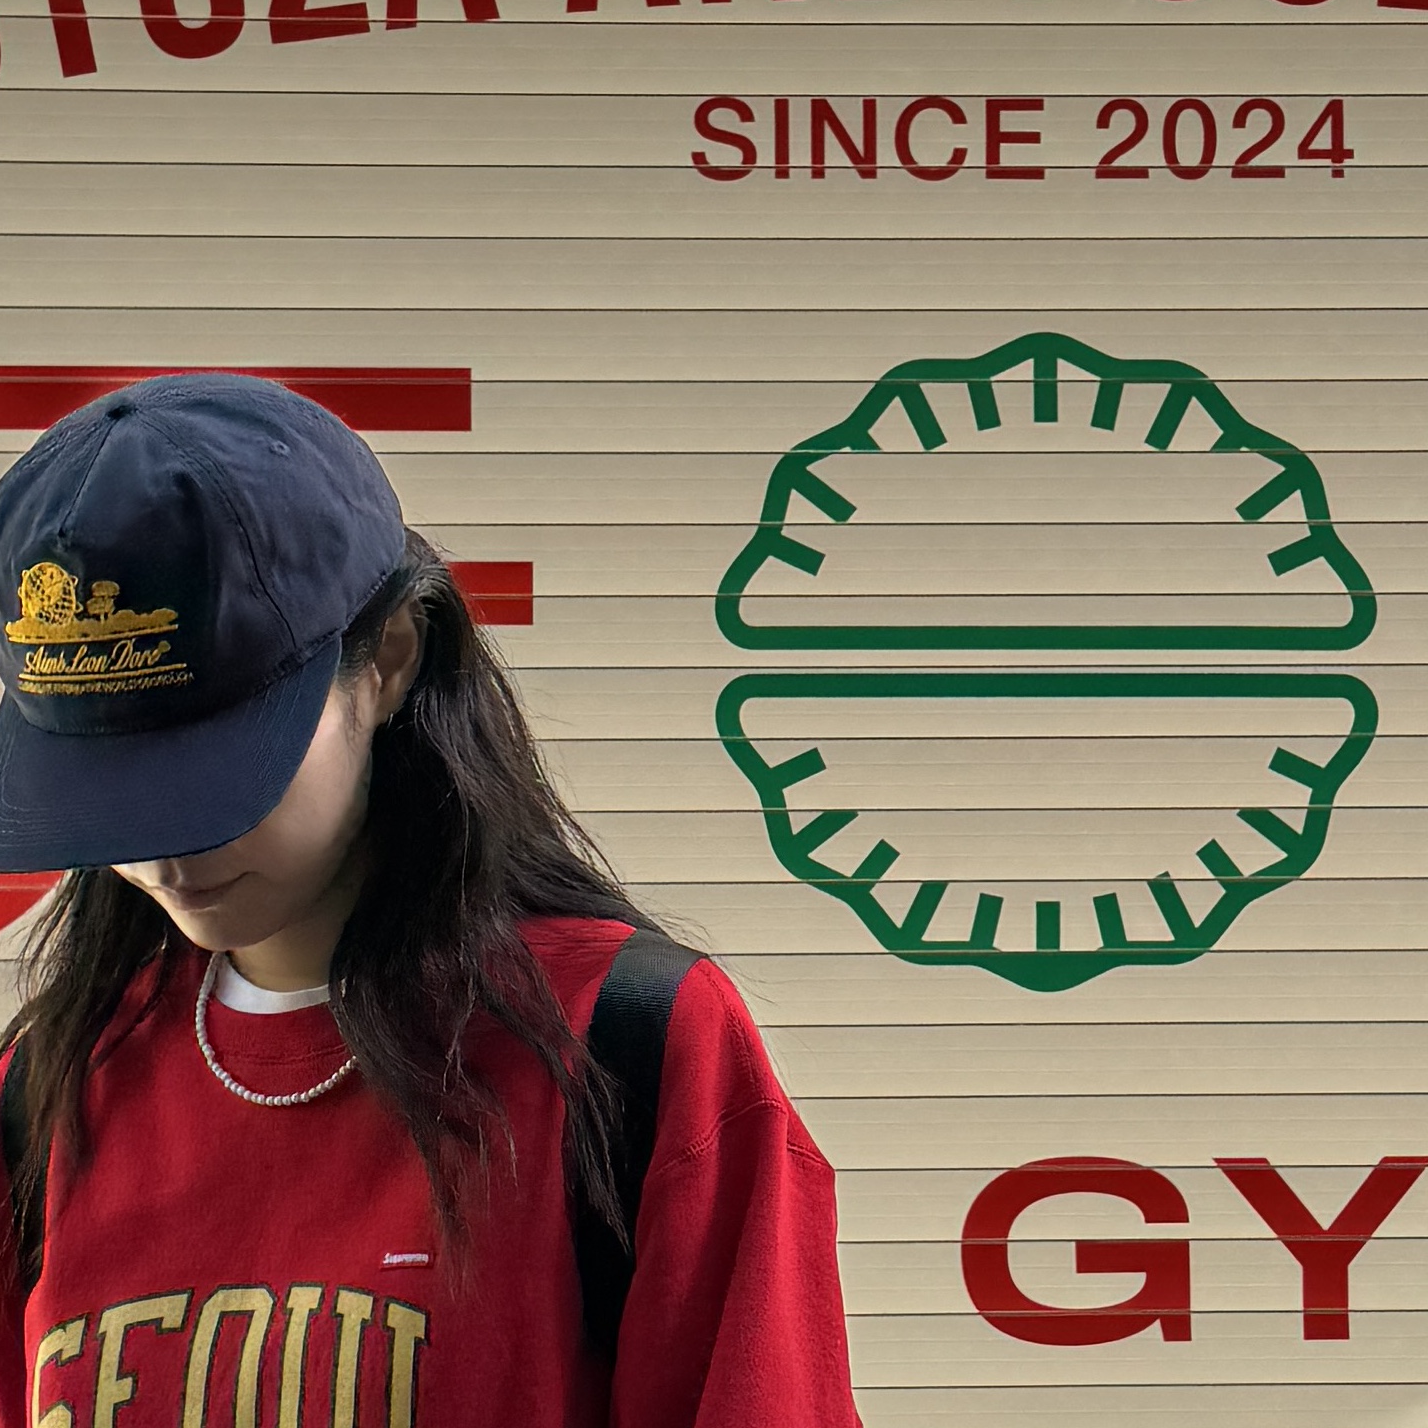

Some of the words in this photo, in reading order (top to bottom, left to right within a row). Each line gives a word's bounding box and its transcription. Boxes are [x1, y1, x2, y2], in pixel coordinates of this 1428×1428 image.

[691, 95, 1045, 181] SINCE
[1094, 98, 1355, 181] 2024
[65, 643, 112, 674] Leon
